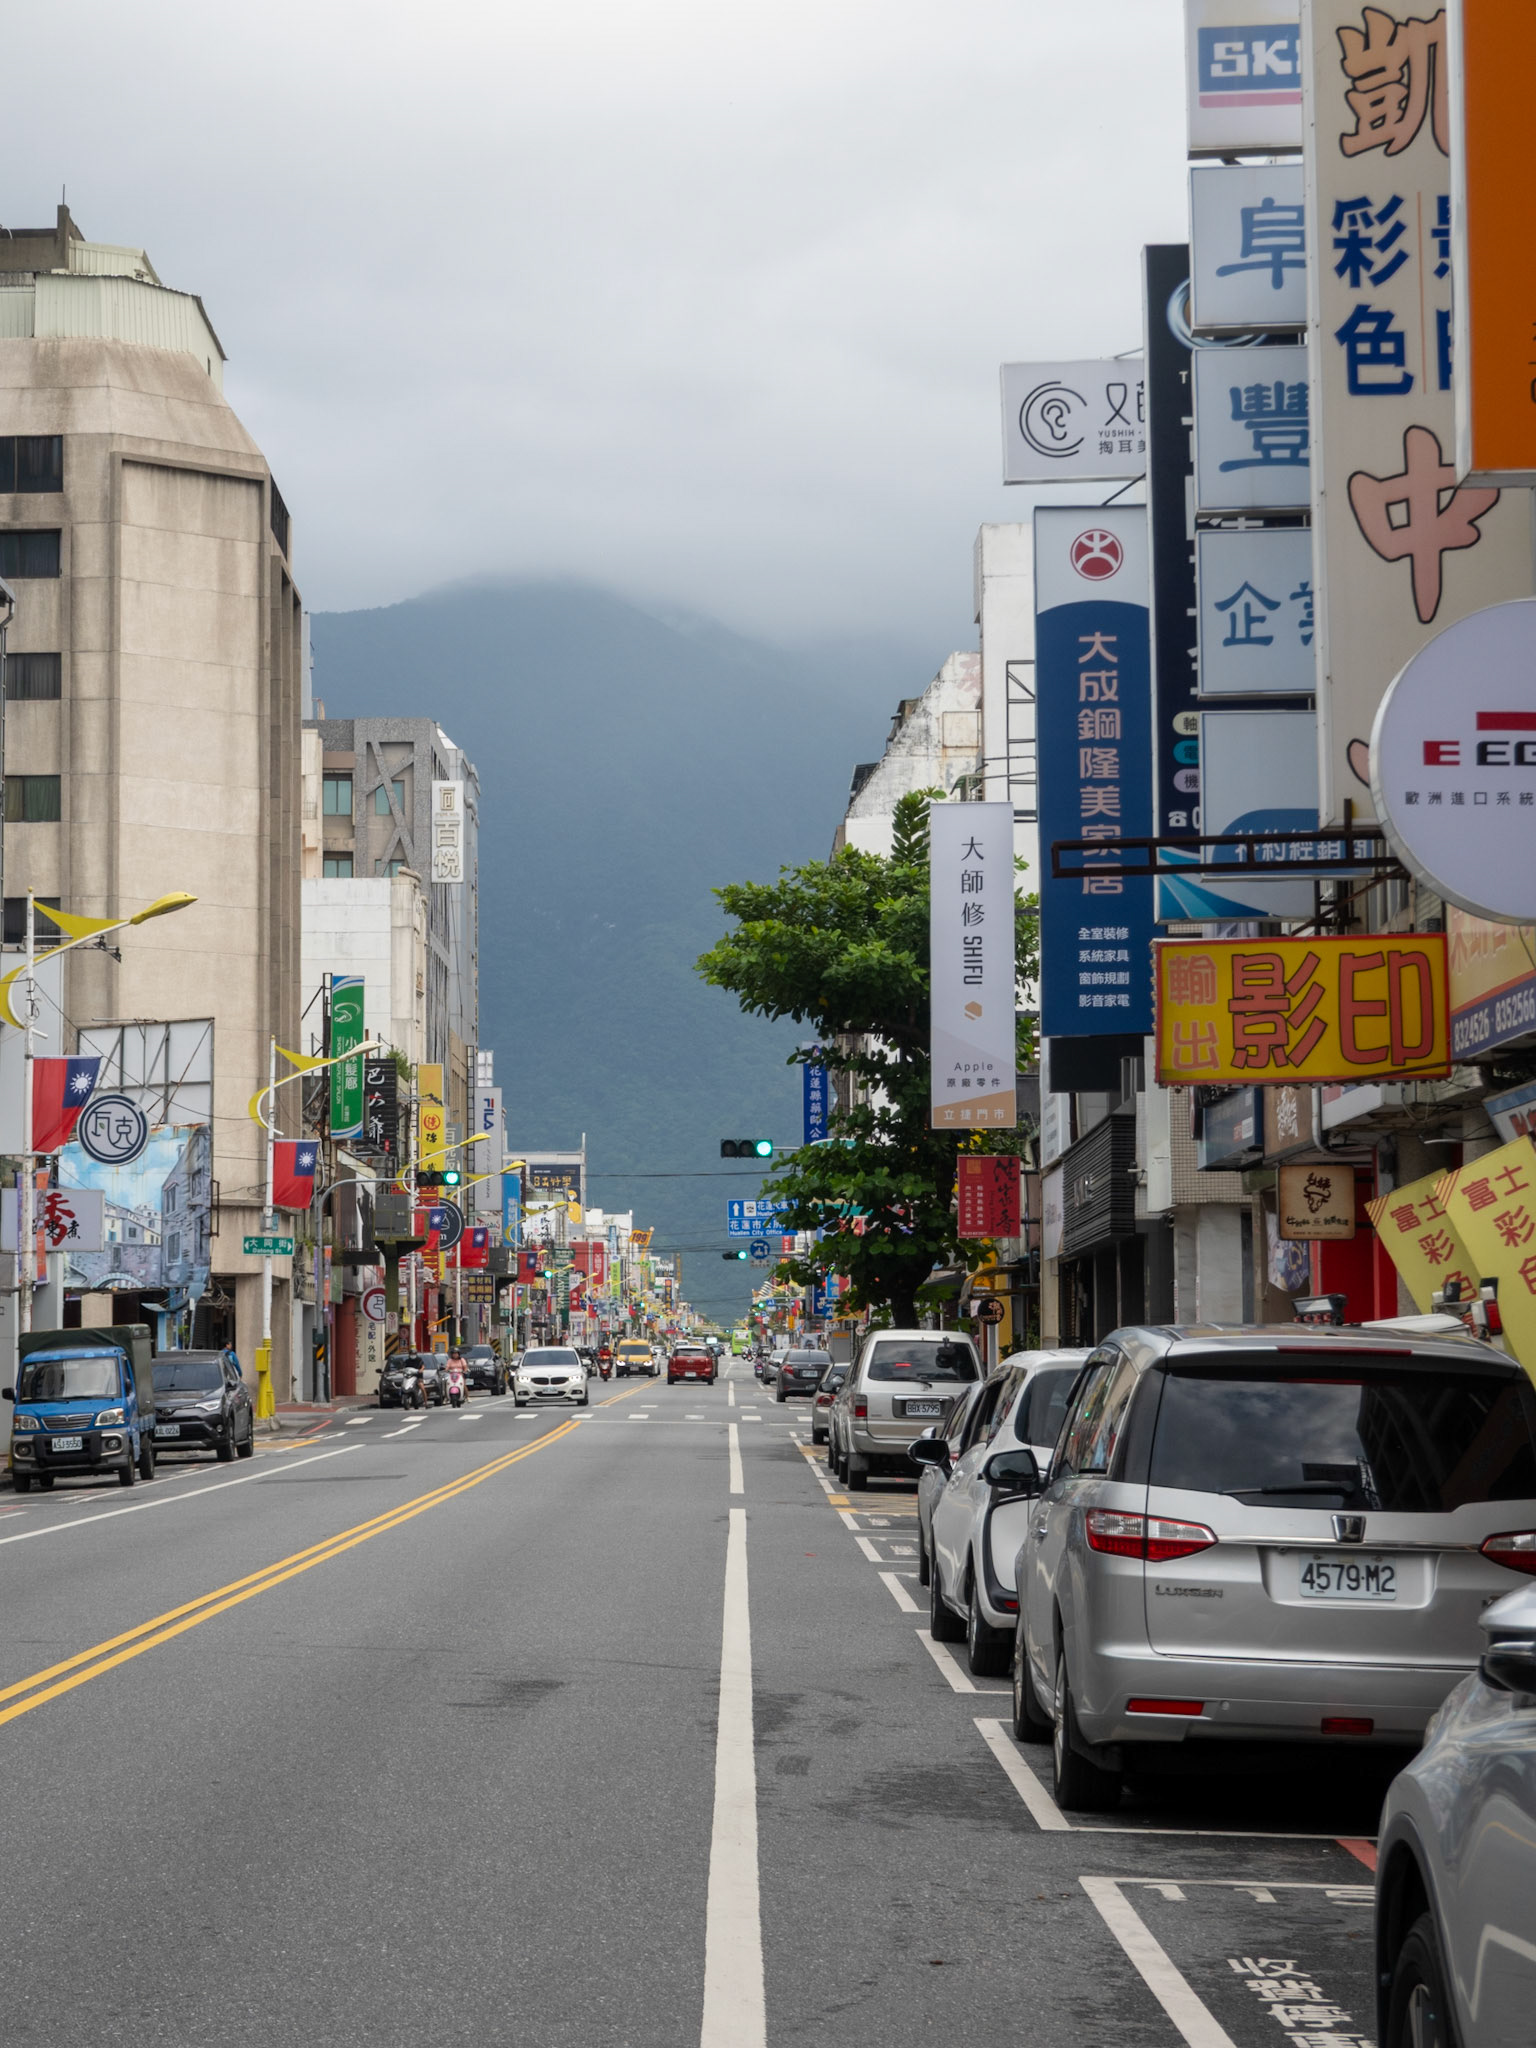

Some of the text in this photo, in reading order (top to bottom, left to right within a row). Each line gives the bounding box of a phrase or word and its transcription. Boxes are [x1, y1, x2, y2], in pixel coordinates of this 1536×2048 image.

[1210, 40, 1301, 78] SK
[1331, 194, 1415, 396] 彩色
[1347, 425, 1501, 625] 中
[1077, 631, 1124, 895] 大成鋼隆美家居
[961, 836, 985, 986] 大師修 SHIFU
[1078, 926, 1129, 941] 全室裝修
[1078, 949, 1130, 963] 系統家具
[1078, 993, 1130, 1008] 影音家電
[1167, 953, 1220, 1071] 輸出
[1228, 951, 1435, 1070] 影印
[954, 1061, 994, 1073] Apple
[91, 1110, 134, 1150] 瓦克
[483, 1097, 495, 1131] FILA
[1460, 1165, 1530, 1213] 富士
[752, 1229, 764, 1237] City
[1389, 1194, 1447, 1234] 富士
[249, 1238, 287, 1248] 大同街
[1155, 1584, 1224, 1599] LUXGEN
